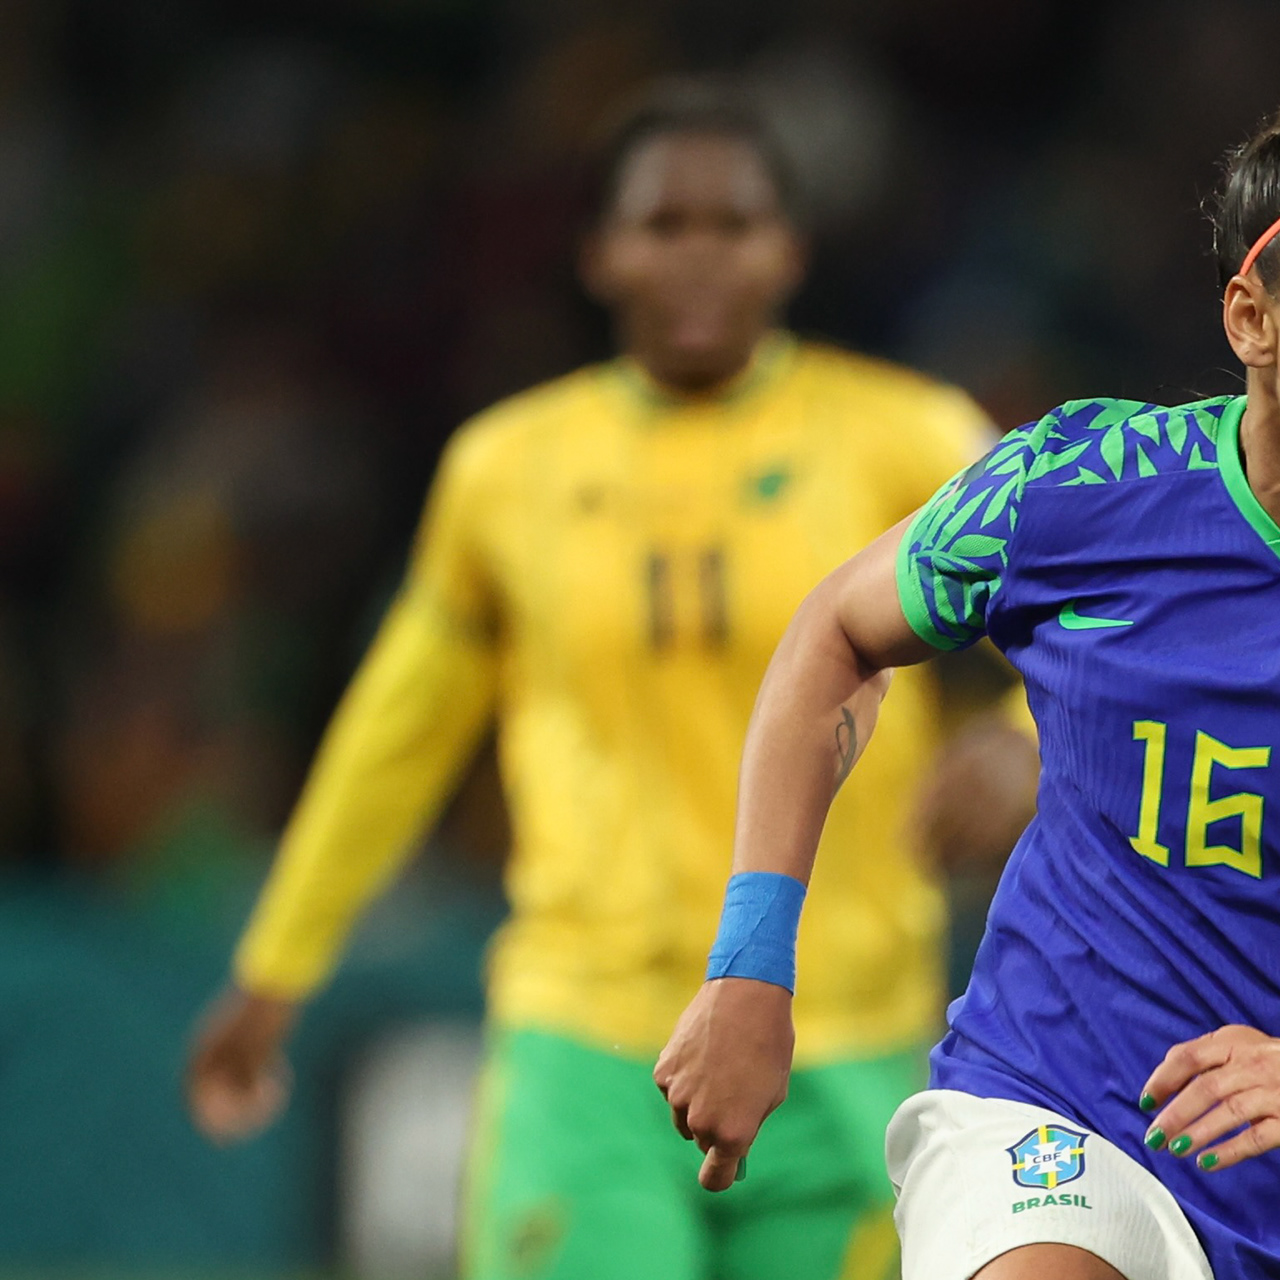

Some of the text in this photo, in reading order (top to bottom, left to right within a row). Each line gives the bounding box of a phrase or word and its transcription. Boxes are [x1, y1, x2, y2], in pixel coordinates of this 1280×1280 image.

[1128, 719, 1272, 880] 16
[1033, 1152, 1062, 1164] CBF
[1012, 1194, 1093, 1214] BRASIL
